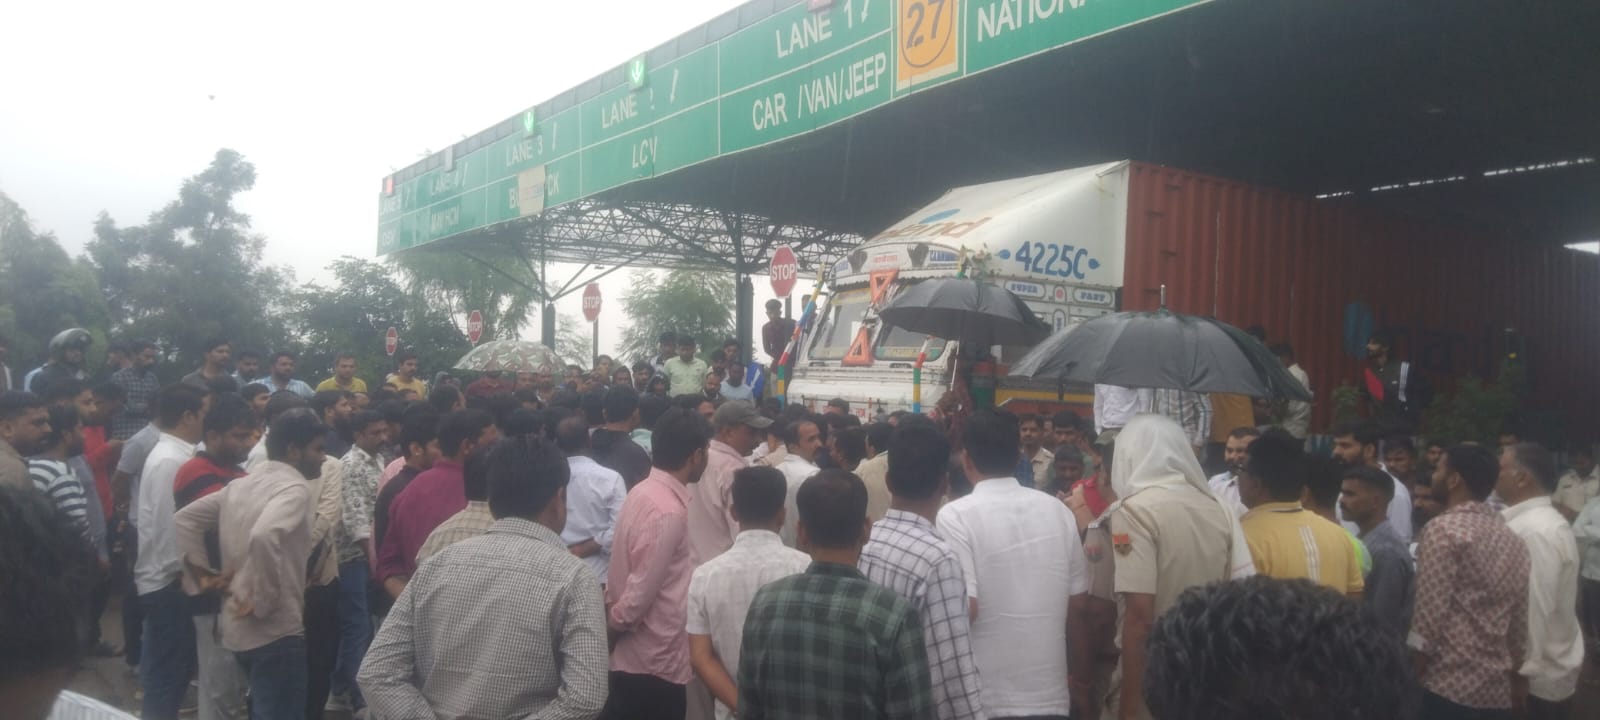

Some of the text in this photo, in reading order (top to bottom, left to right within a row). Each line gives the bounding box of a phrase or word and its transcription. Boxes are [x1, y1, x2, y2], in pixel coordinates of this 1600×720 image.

[776, 0, 852, 58] LANE 1
[906, 0, 942, 48] 27
[977, 0, 1085, 42] NATION
[601, 93, 638, 128] LANE
[752, 93, 788, 130] CAR
[506, 139, 534, 167] LANE
[632, 136, 658, 168] LCV
[771, 264, 797, 280] STOP
[1015, 240, 1088, 280] 4225C
[583, 293, 601, 308] STOP
